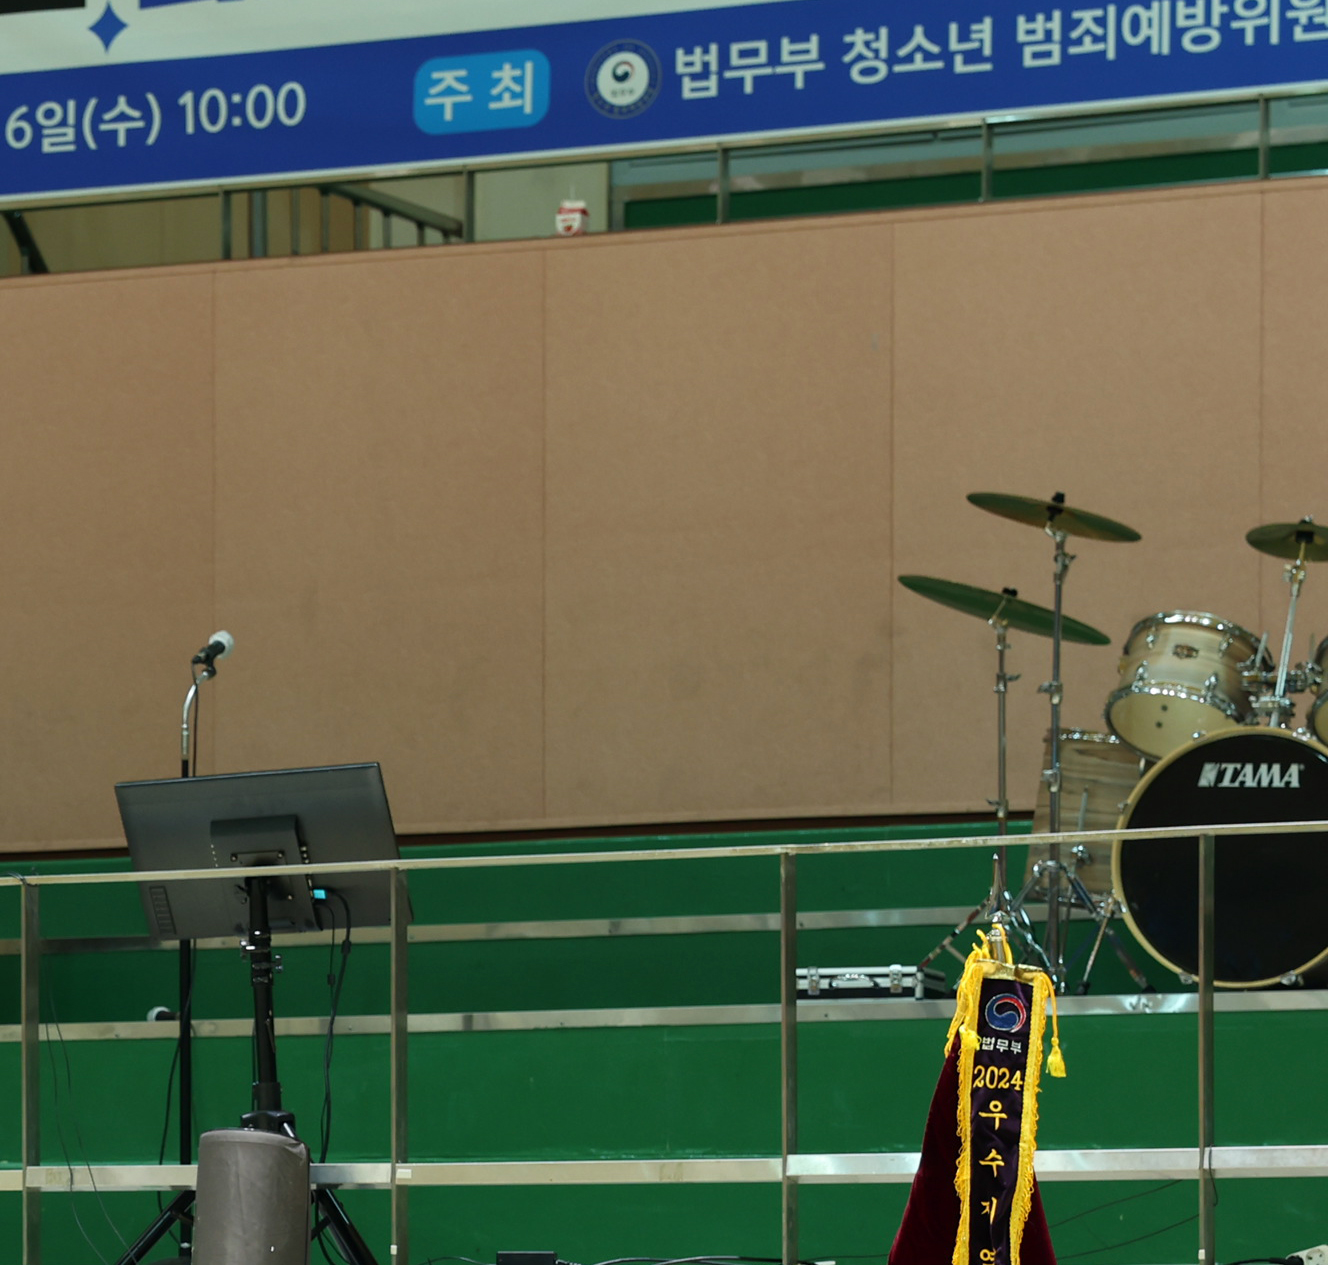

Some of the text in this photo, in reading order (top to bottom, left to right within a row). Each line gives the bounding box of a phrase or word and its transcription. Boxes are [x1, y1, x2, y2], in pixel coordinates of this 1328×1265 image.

[675, 36, 826, 99] 법무부
[841, 17, 994, 86] 청소년
[4, 92, 162, 153] 6일(수)
[176, 81, 307, 135] 10:00
[1217, 762, 1301, 788] TAMA
[982, 1036, 1022, 1054] 법무부
[973, 1065, 1024, 1091] 2024
